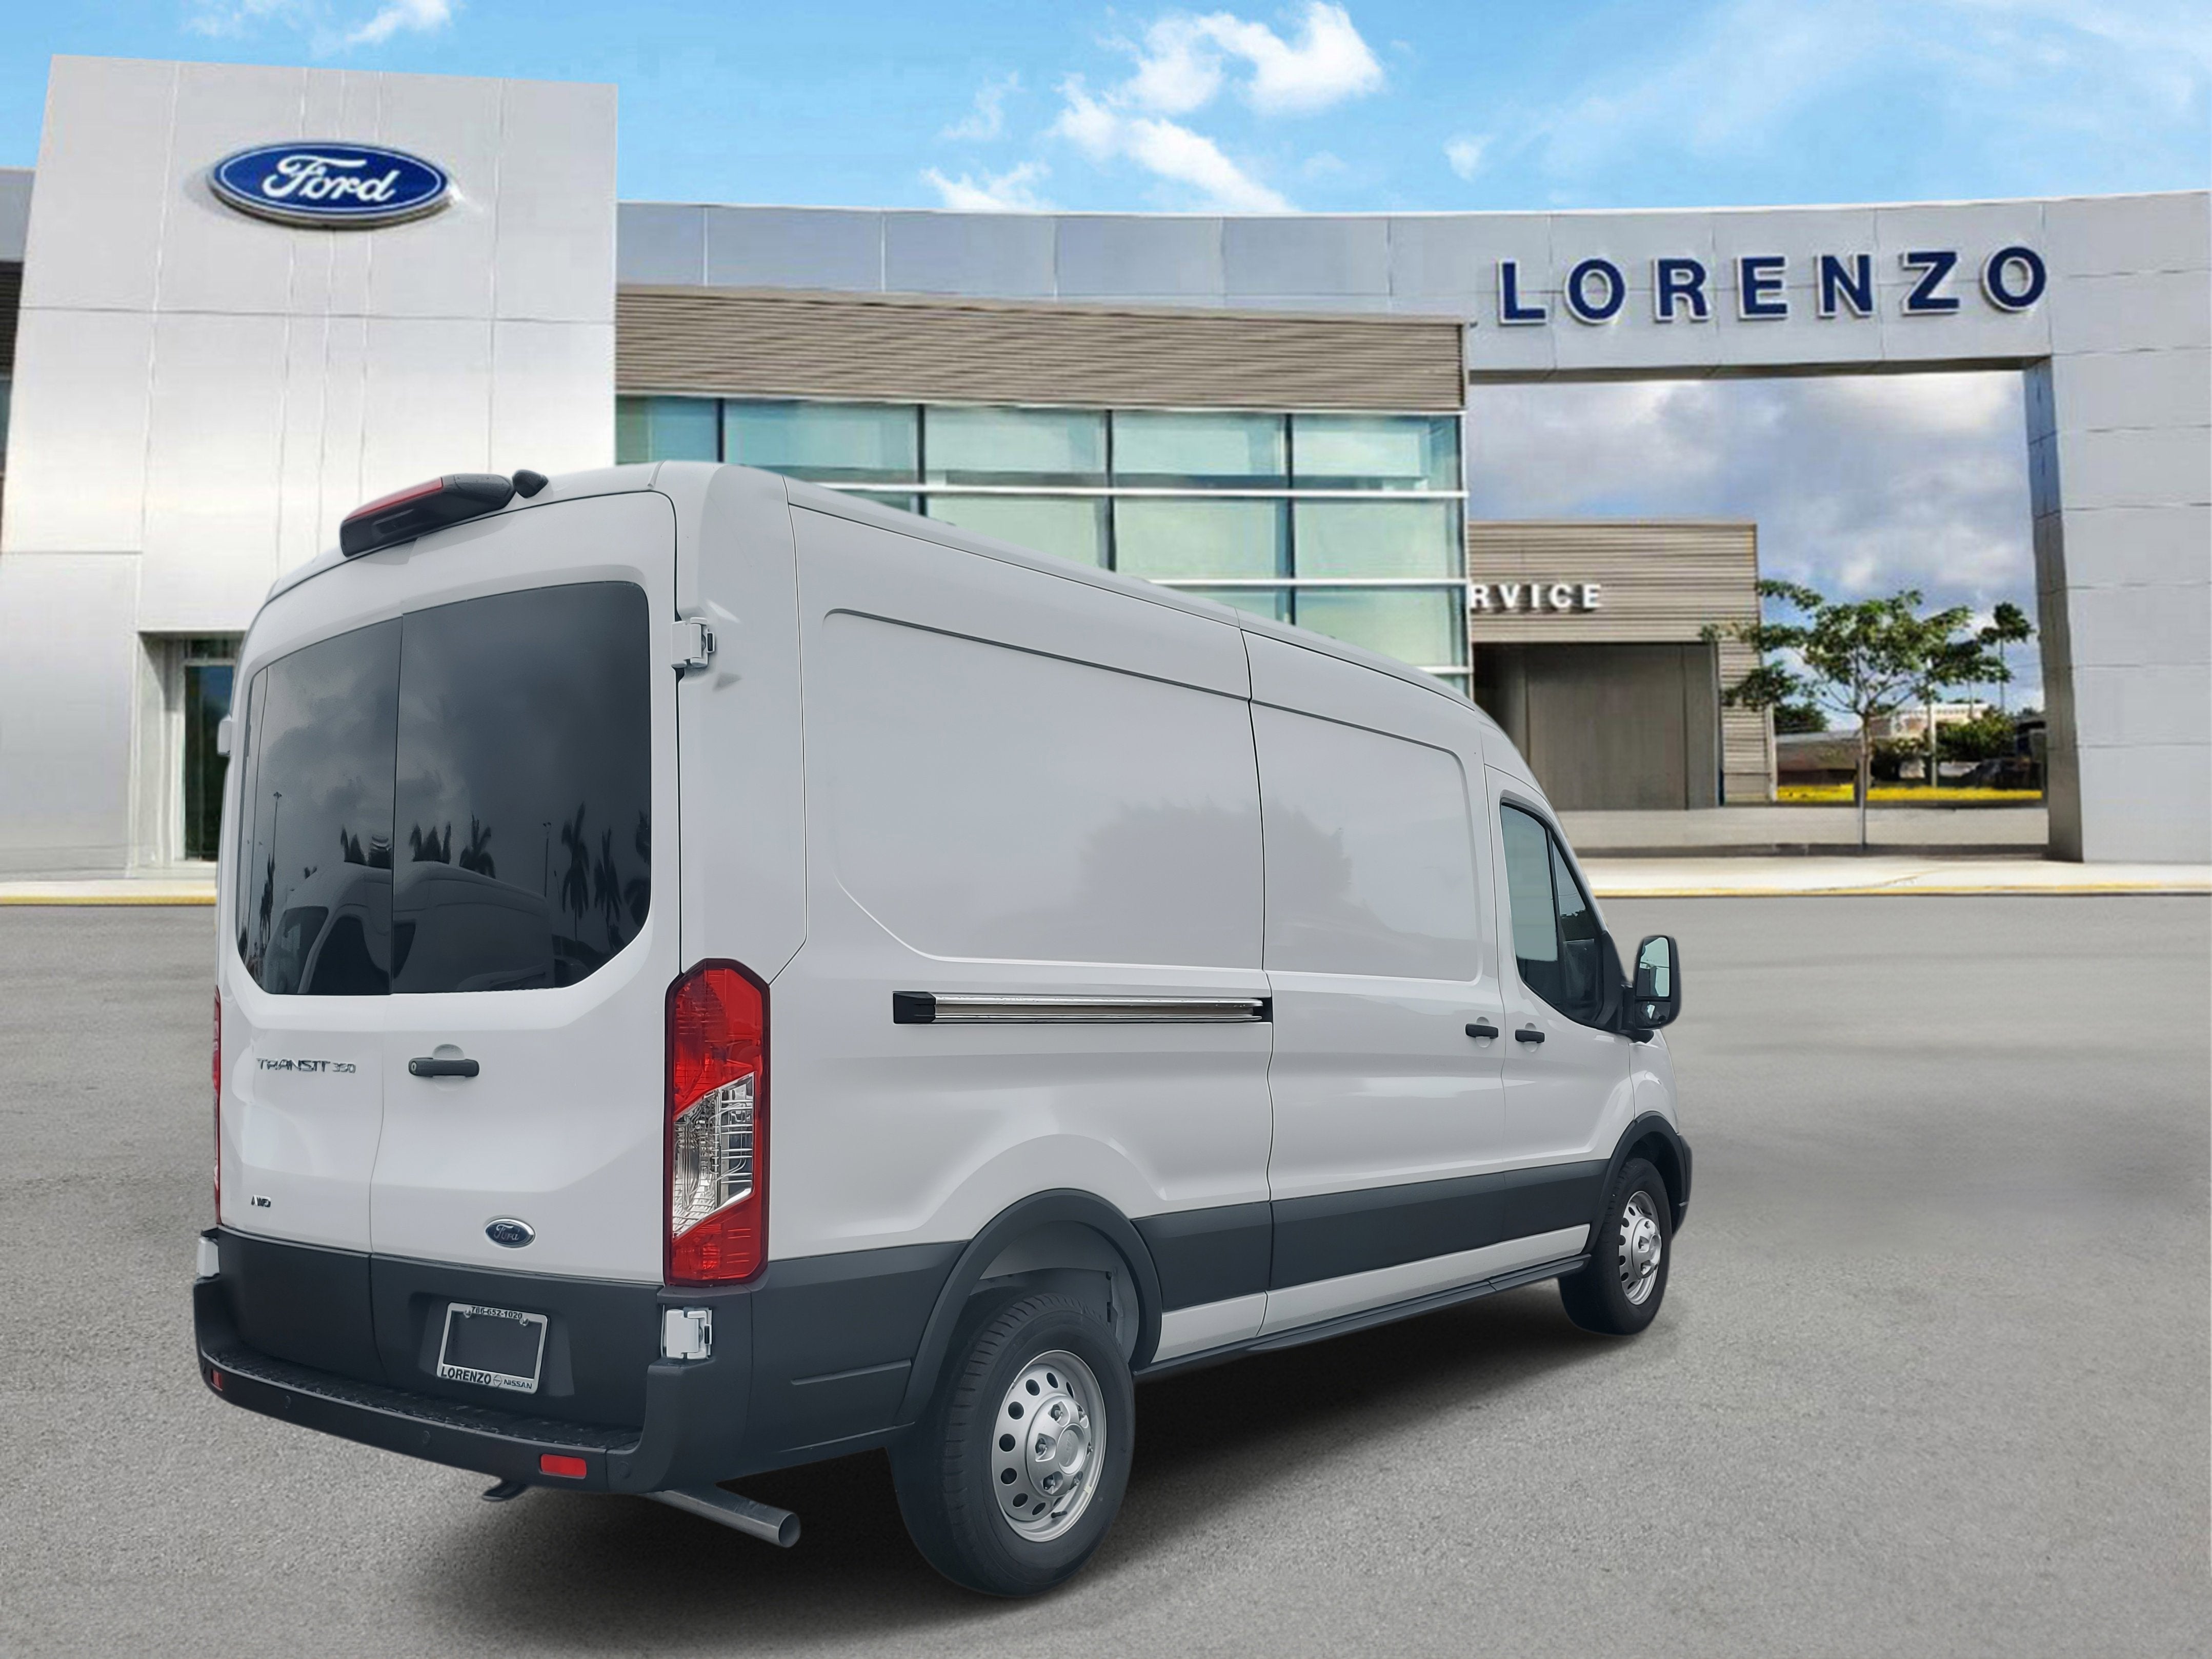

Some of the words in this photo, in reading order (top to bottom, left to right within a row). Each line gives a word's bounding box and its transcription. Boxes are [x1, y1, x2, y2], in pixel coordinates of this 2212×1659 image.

[262, 154, 400, 202] Ford
[1498, 246, 2047, 325] LORENZO
[256, 1058, 331, 1072] TRANSIT
[332, 1063, 356, 1073] 350
[493, 1224, 520, 1241] Ford
[471, 1306, 522, 1319] 786-652-1020
[441, 1366, 491, 1385] LORENZO
[504, 1379, 532, 1389] NISSAN
